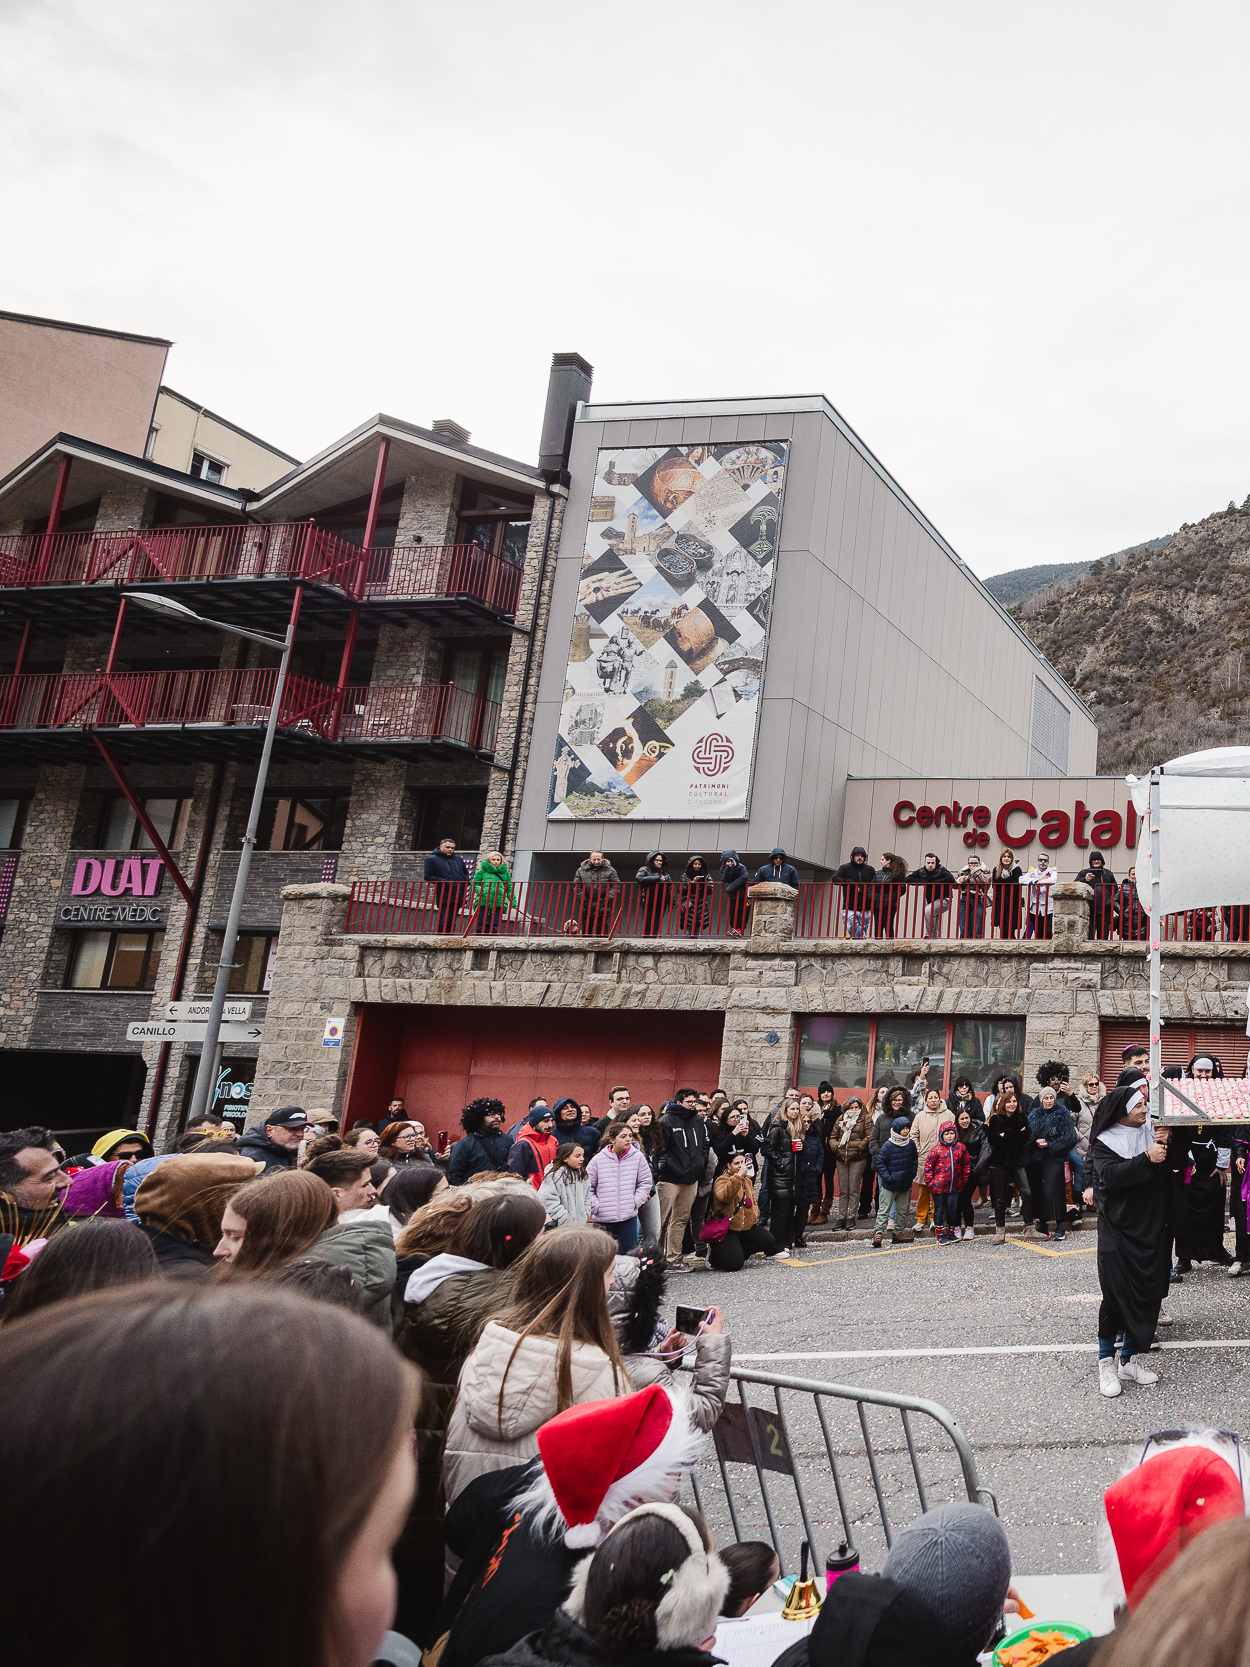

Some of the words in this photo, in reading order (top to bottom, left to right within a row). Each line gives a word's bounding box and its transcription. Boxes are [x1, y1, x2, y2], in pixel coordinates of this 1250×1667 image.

[893, 800, 991, 827] Centre
[996, 800, 1138, 848] Catal
[963, 828, 990, 847] de
[60, 905, 113, 921] CENTRE
[115, 903, 161, 921] MÈDIC
[188, 1006, 210, 1014] ANDOR
[227, 1006, 246, 1014] VELLA
[132, 1027, 176, 1036] CANILLO
